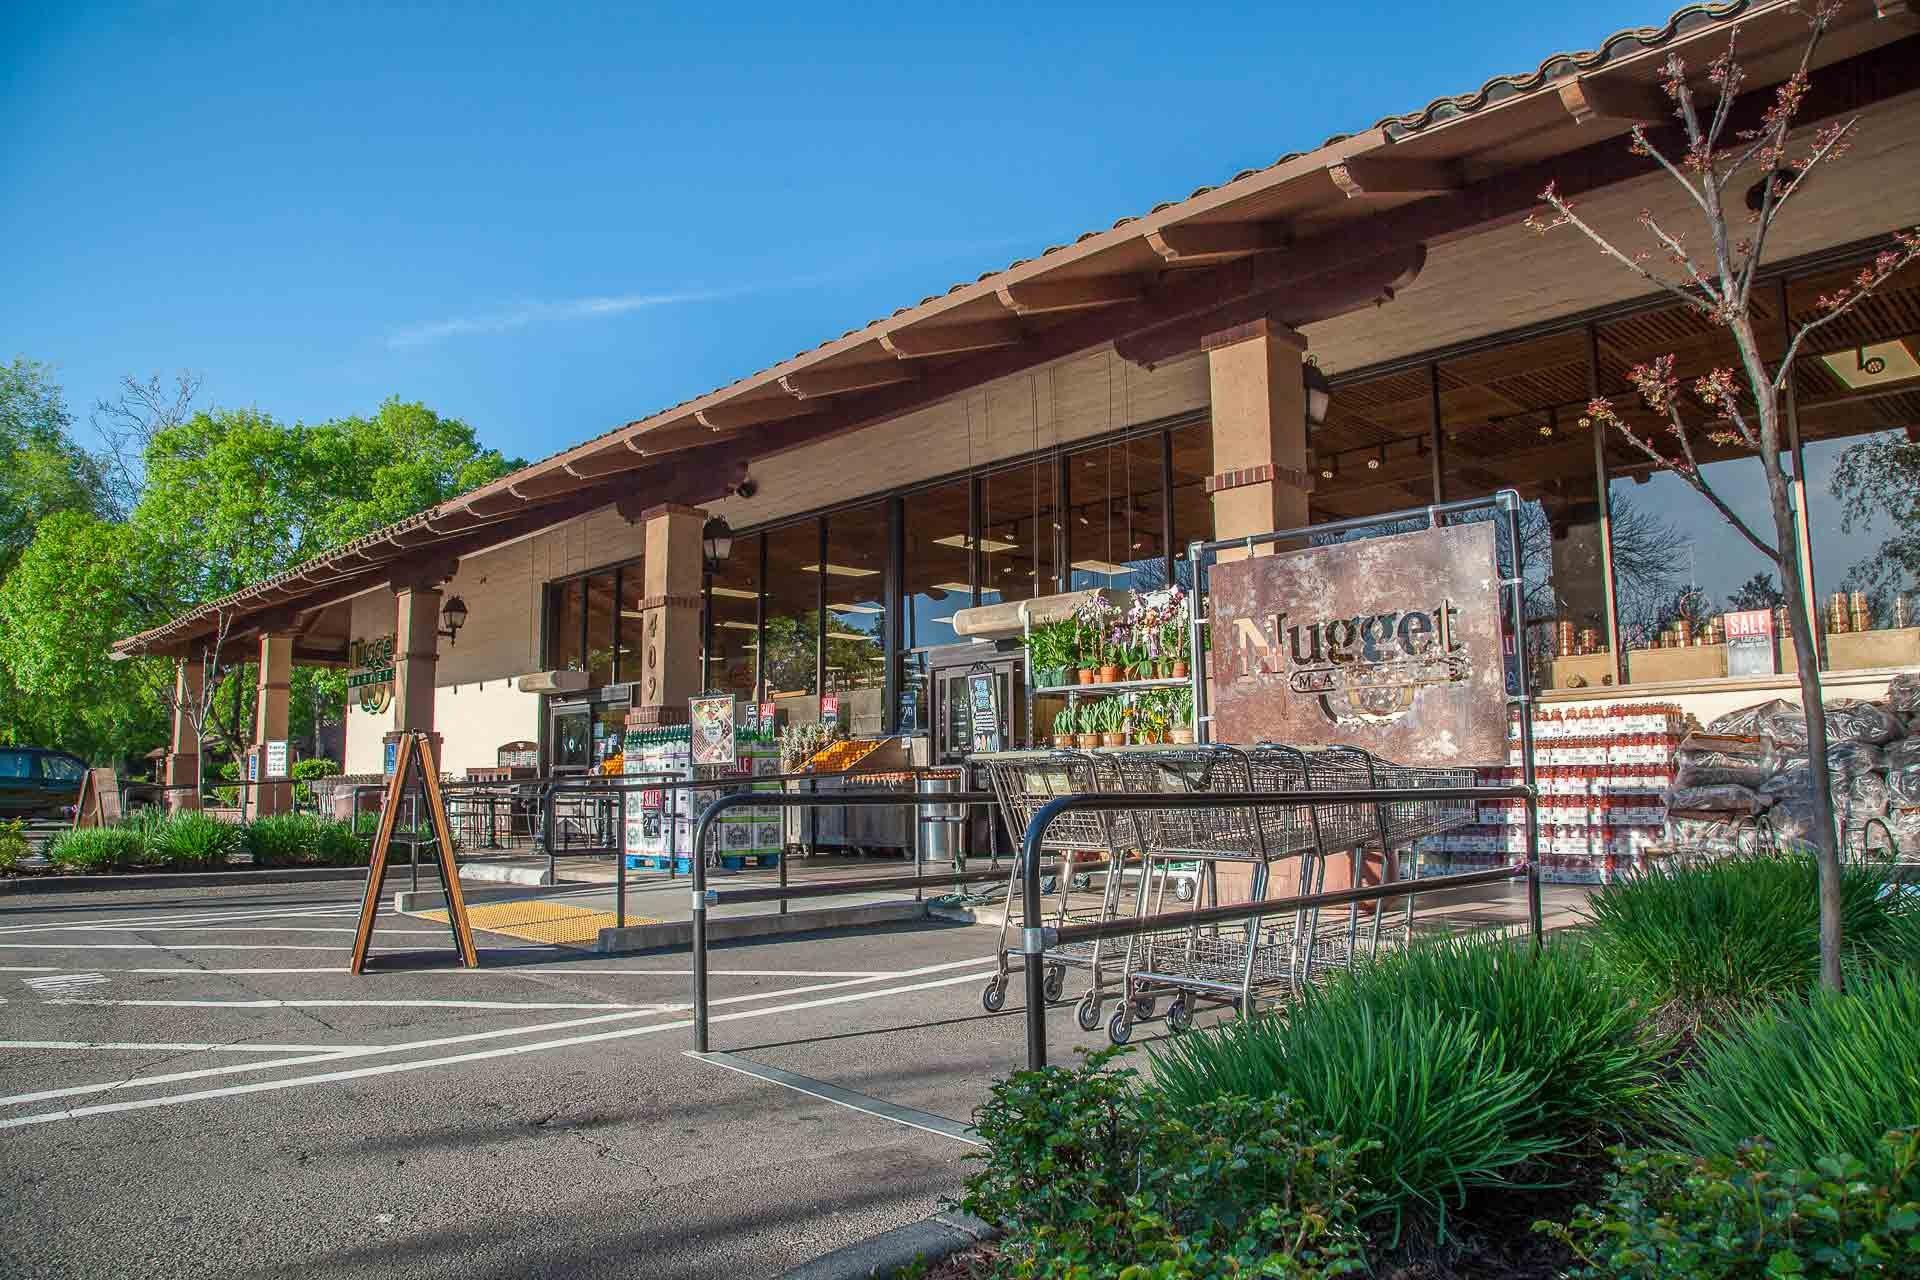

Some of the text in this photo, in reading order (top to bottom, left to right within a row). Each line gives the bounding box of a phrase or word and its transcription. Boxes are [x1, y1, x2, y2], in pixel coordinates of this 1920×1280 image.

[1729, 612, 1767, 636] SALE
[1232, 600, 1458, 677] Nugget
[643, 790, 660, 807] SALE
